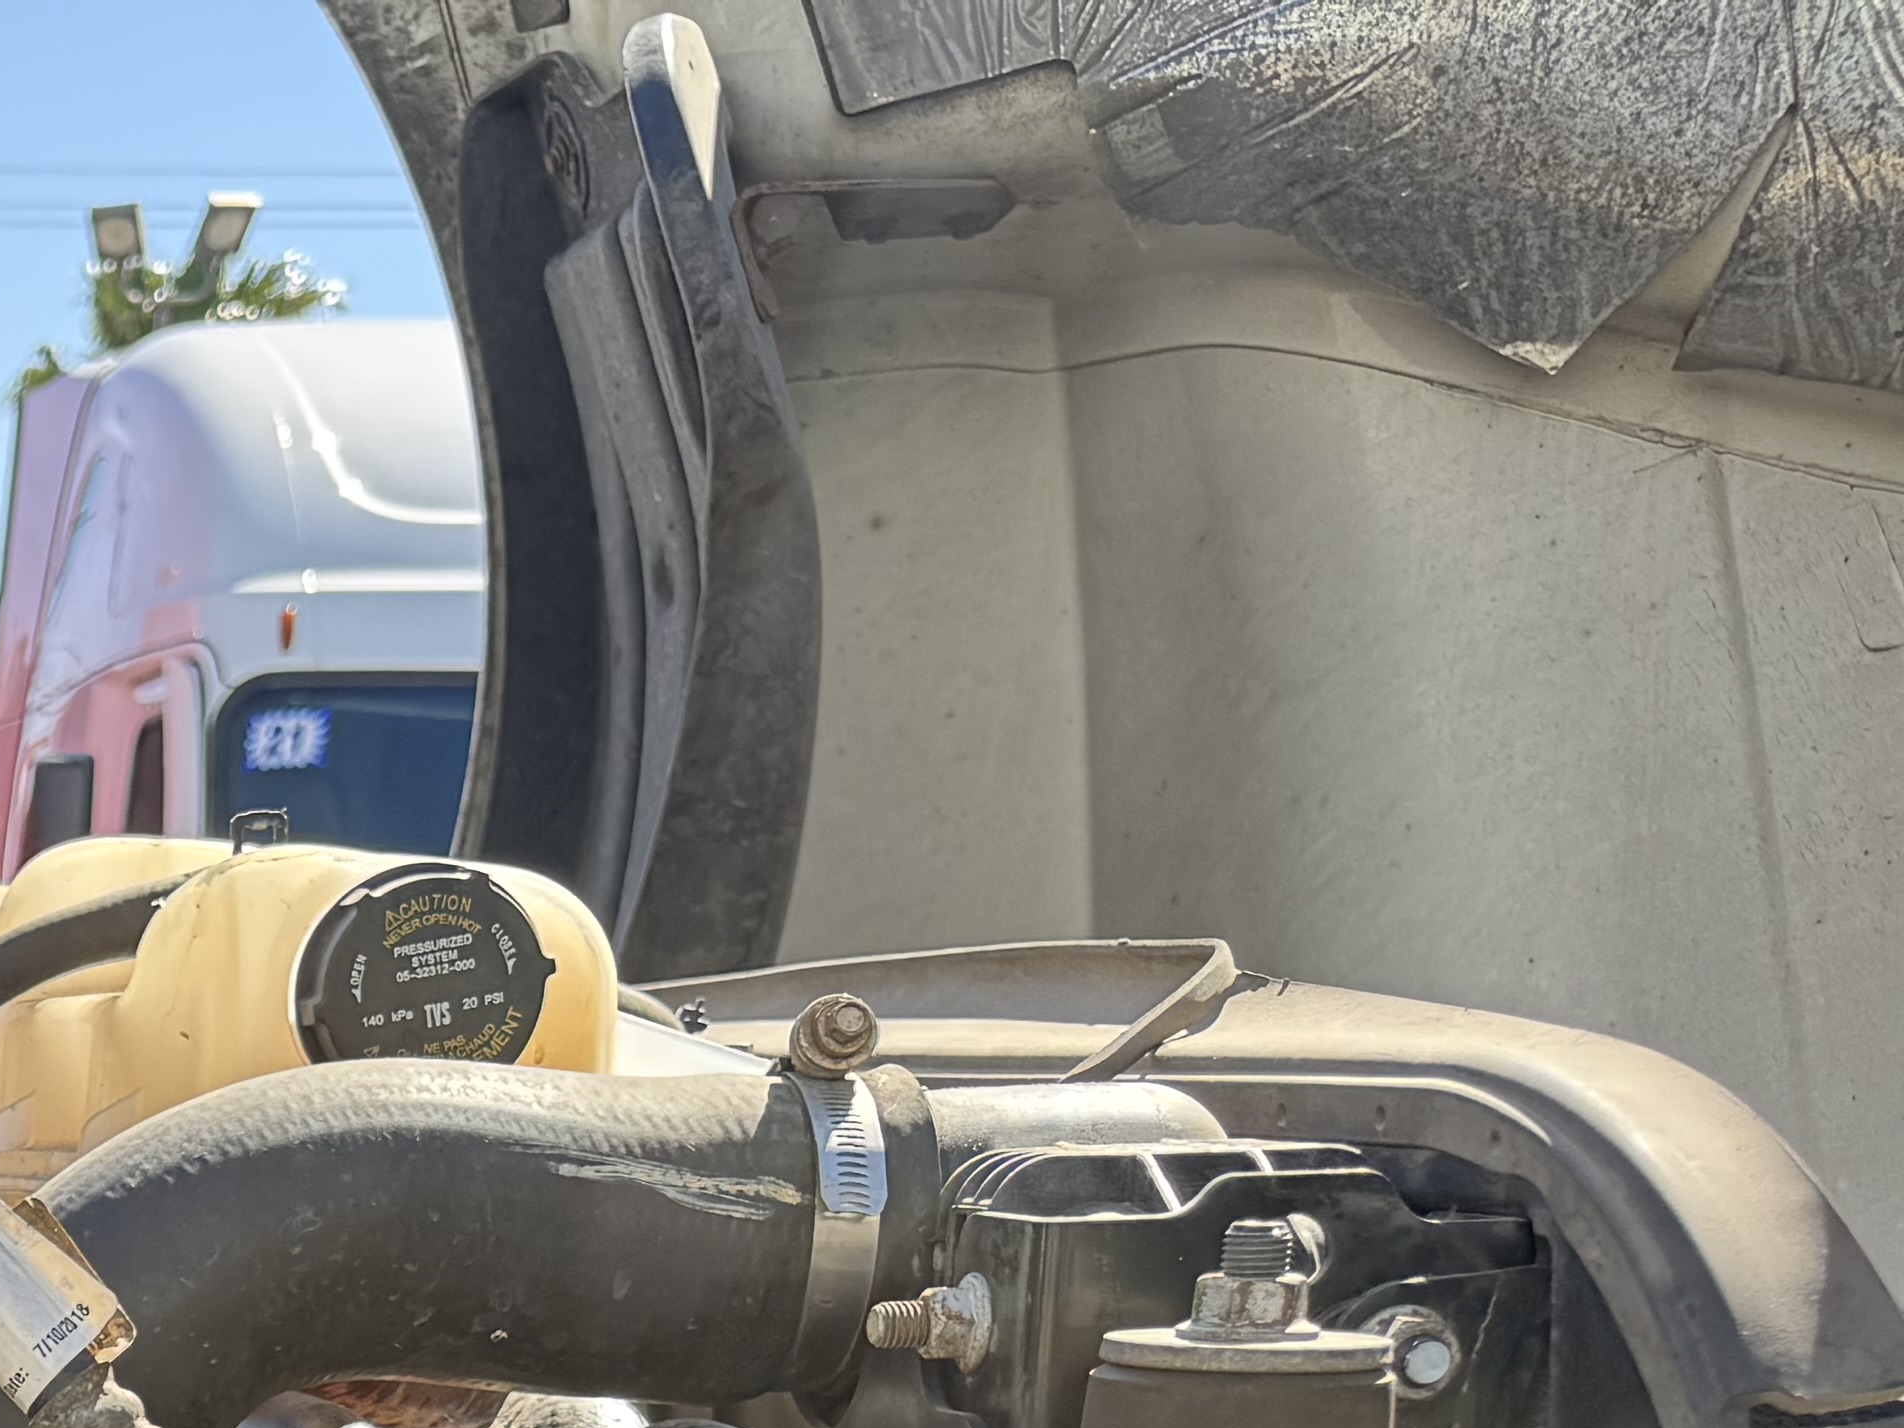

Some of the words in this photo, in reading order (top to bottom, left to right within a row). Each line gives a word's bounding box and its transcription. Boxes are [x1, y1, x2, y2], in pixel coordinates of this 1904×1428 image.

[399, 893, 472, 920] CAUTION
[383, 918, 421, 949] NEVER
[422, 913, 456, 927] OPEN
[456, 916, 482, 935] HOT
[394, 933, 473, 958] PRESSURIZED
[490, 923, 518, 960] CLOSE
[350, 953, 368, 986] OPEN
[411, 950, 459, 968] SYSTEM
[362, 1013, 385, 1028] 140
[391, 1009, 414, 1022] kPa
[424, 1002, 451, 1028] TVS
[462, 997, 479, 1010] 20
[484, 991, 505, 1005] PSI
[472, 1005, 524, 1060] EMENT
[32, 1302, 91, 1359] 7/10/2018
